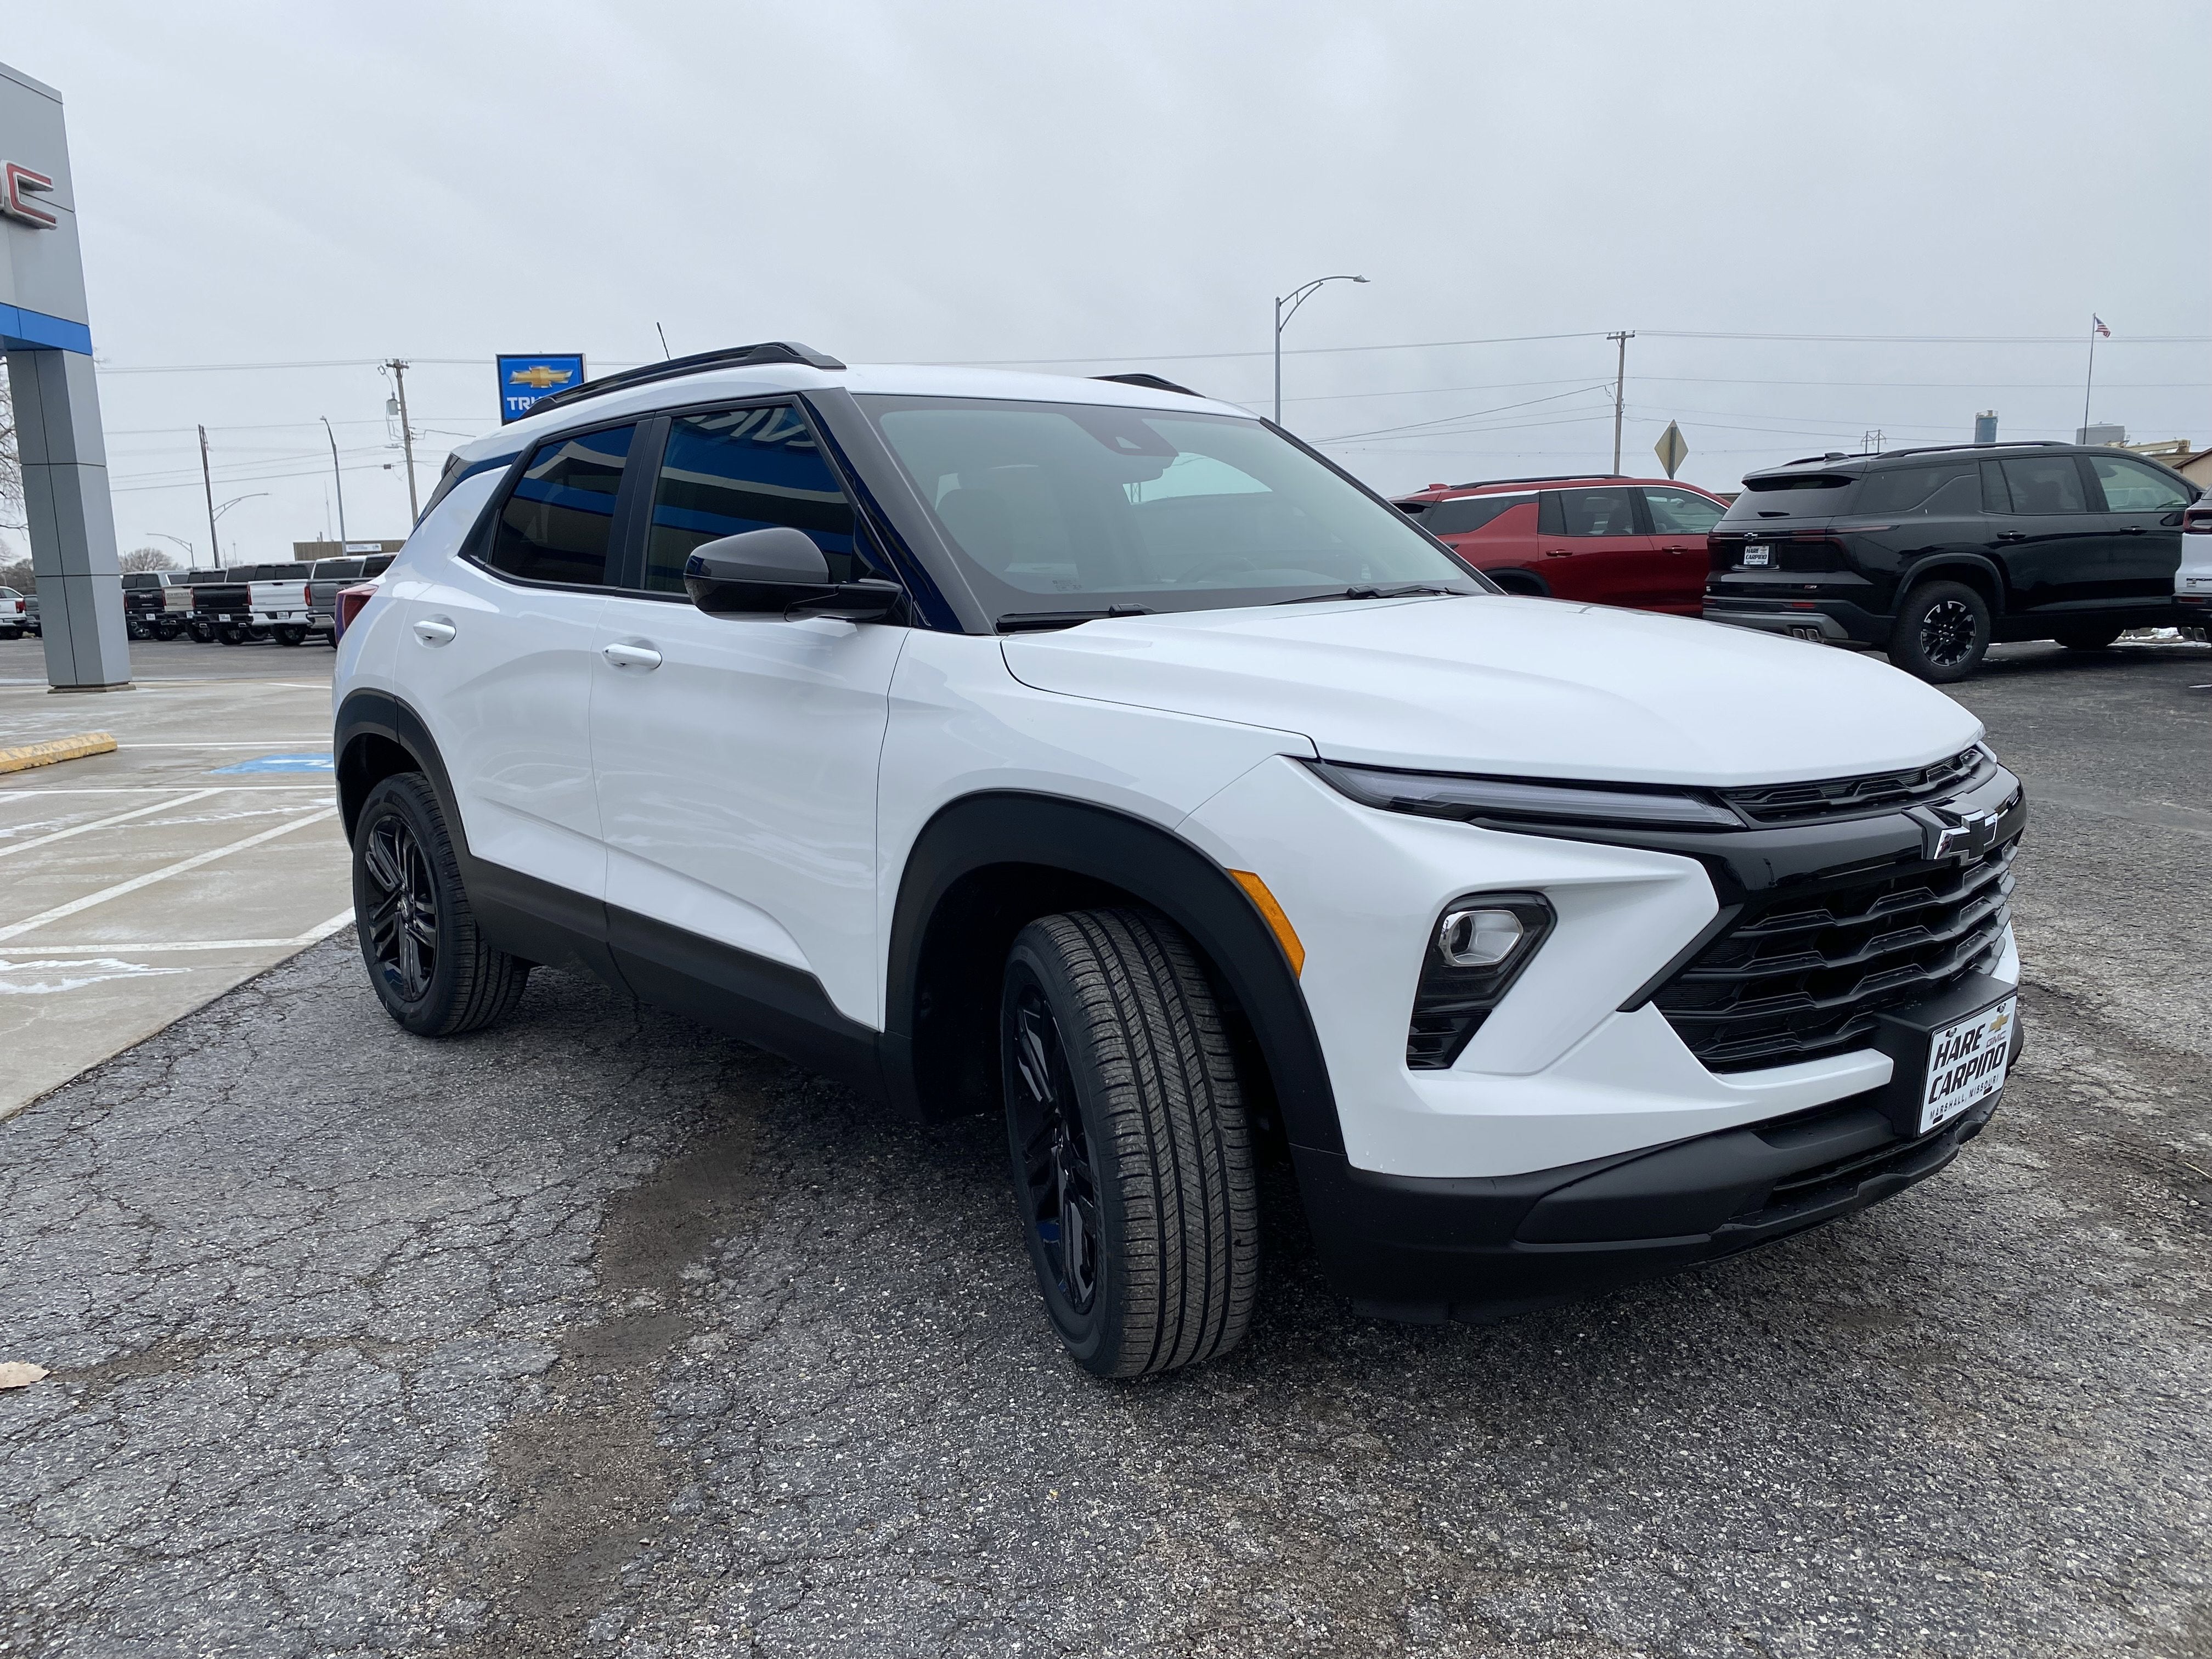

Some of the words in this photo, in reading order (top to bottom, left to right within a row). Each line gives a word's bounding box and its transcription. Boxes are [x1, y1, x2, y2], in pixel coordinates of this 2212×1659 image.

[1932, 1023, 1986, 1071] HARE
[1985, 1030, 2007, 1048] GMC
[1928, 1041, 2007, 1104] CARPINO
[1929, 1093, 1967, 1120] MARSHALL,
[1969, 1074, 1999, 1098] MISSOURI
